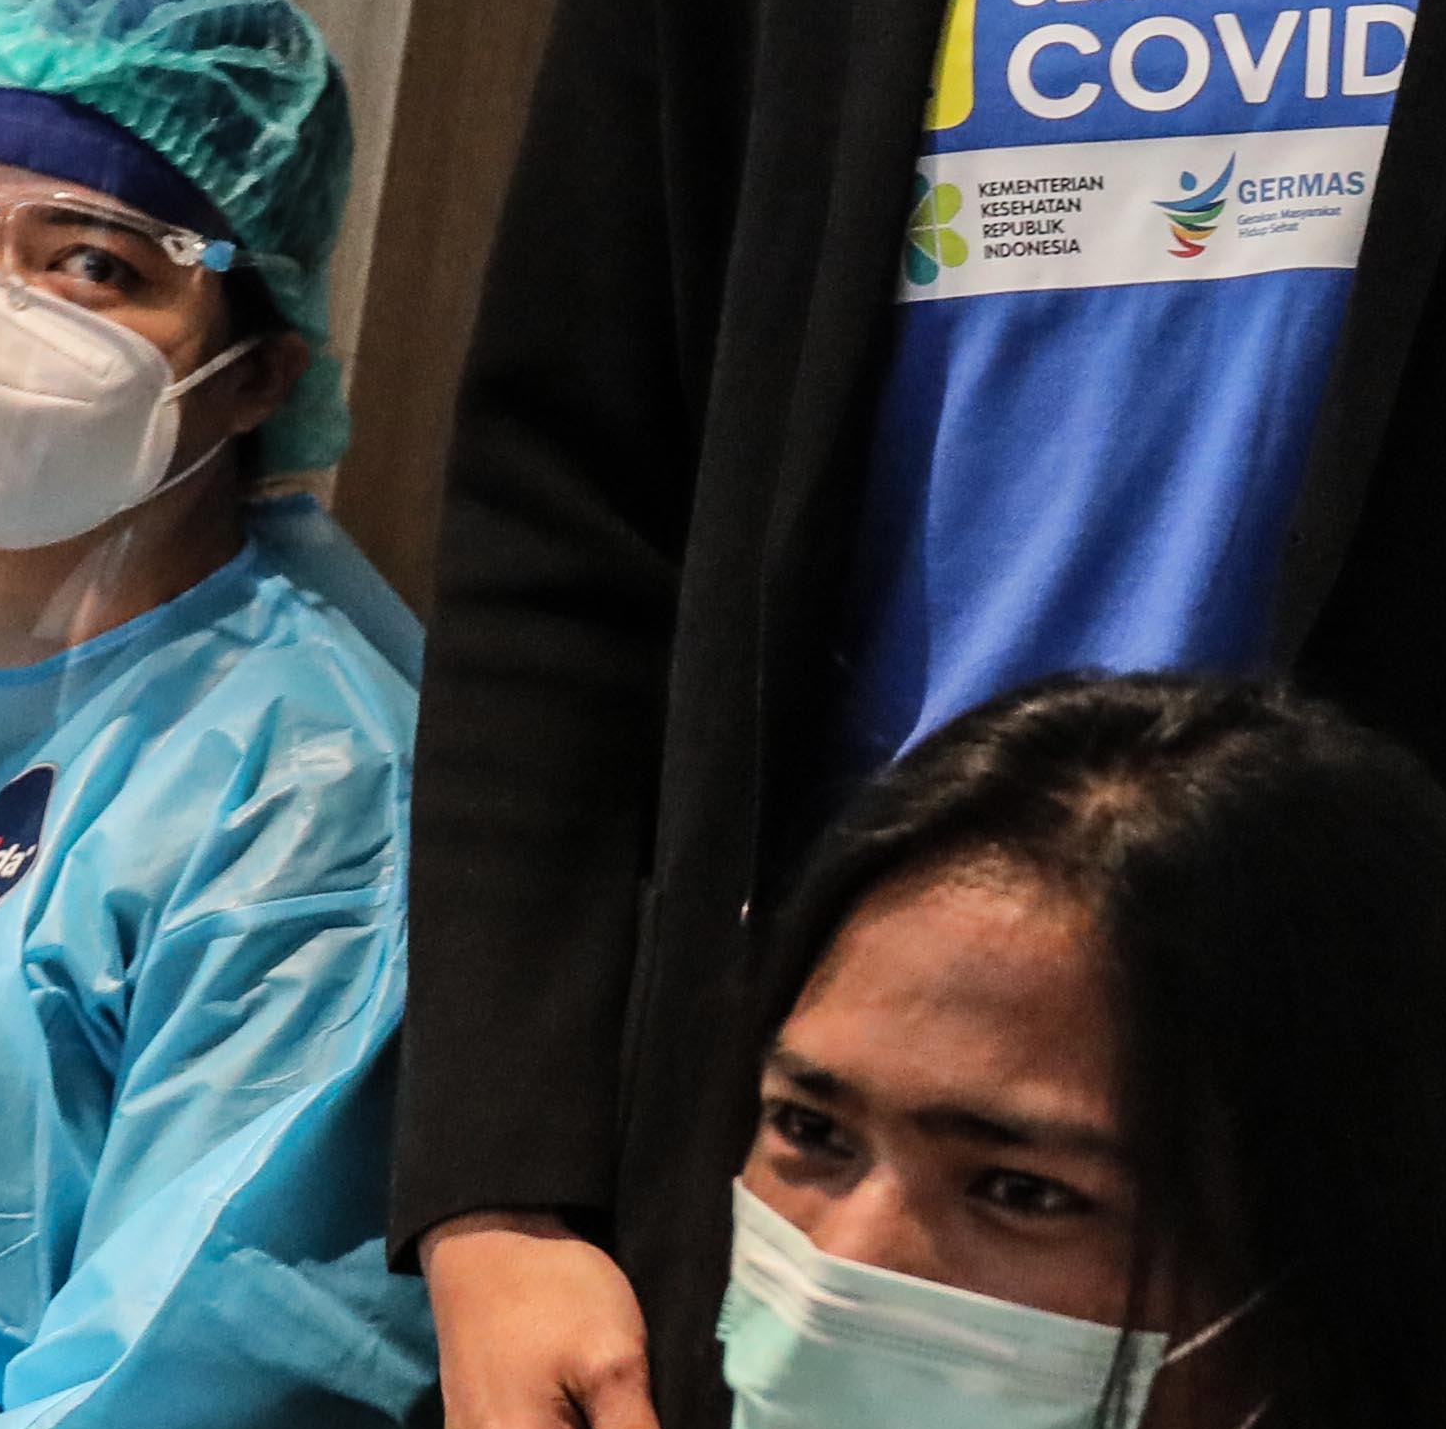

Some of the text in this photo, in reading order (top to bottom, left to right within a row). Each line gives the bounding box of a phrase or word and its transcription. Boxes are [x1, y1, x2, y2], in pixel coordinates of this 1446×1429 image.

[1006, 4, 1417, 120] COVID
[978, 176, 1104, 198] KEMENTERIAN
[1238, 171, 1365, 204] GERMAS
[981, 198, 1082, 218] KESEHATAN
[983, 219, 1065, 238] REPUBLIK
[984, 239, 1082, 259] INDONESIA
